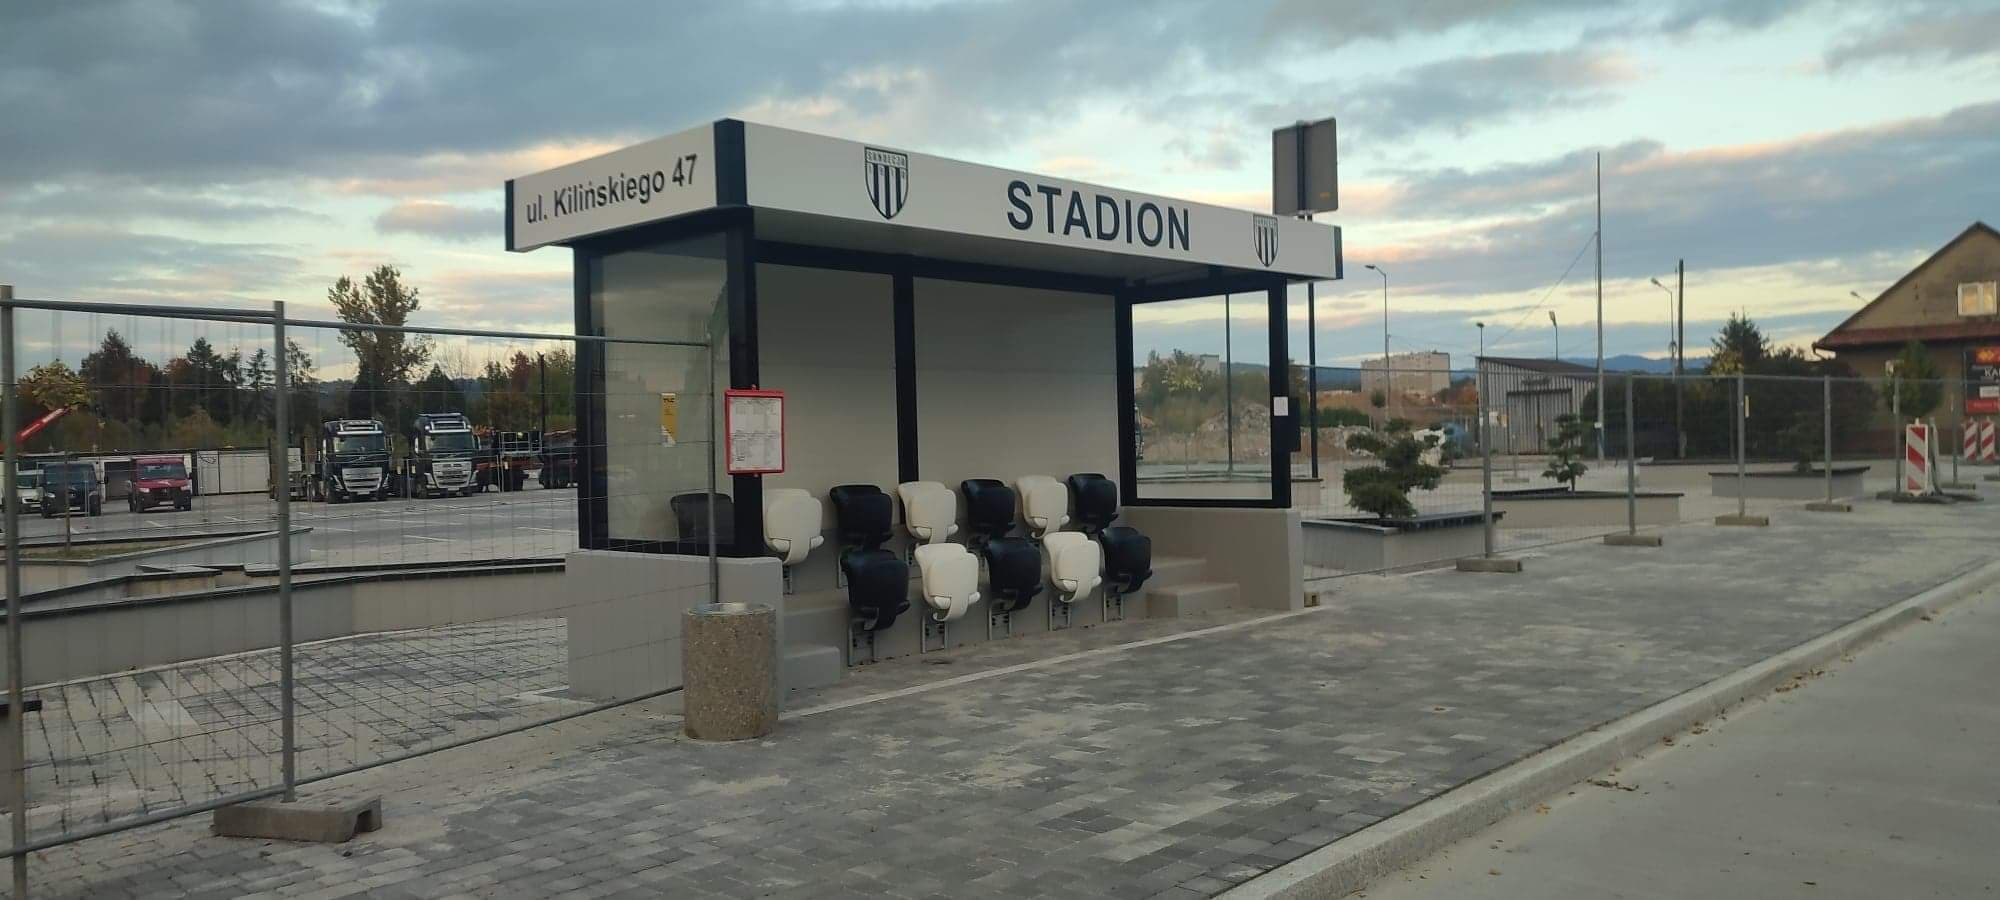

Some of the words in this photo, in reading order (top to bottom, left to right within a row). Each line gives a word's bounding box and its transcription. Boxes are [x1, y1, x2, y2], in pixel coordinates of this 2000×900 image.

[527, 194, 548, 224] ul.
[554, 170, 665, 217] Kilińskiego
[672, 153, 698, 188] 47
[1007, 180, 1190, 251] STADION
